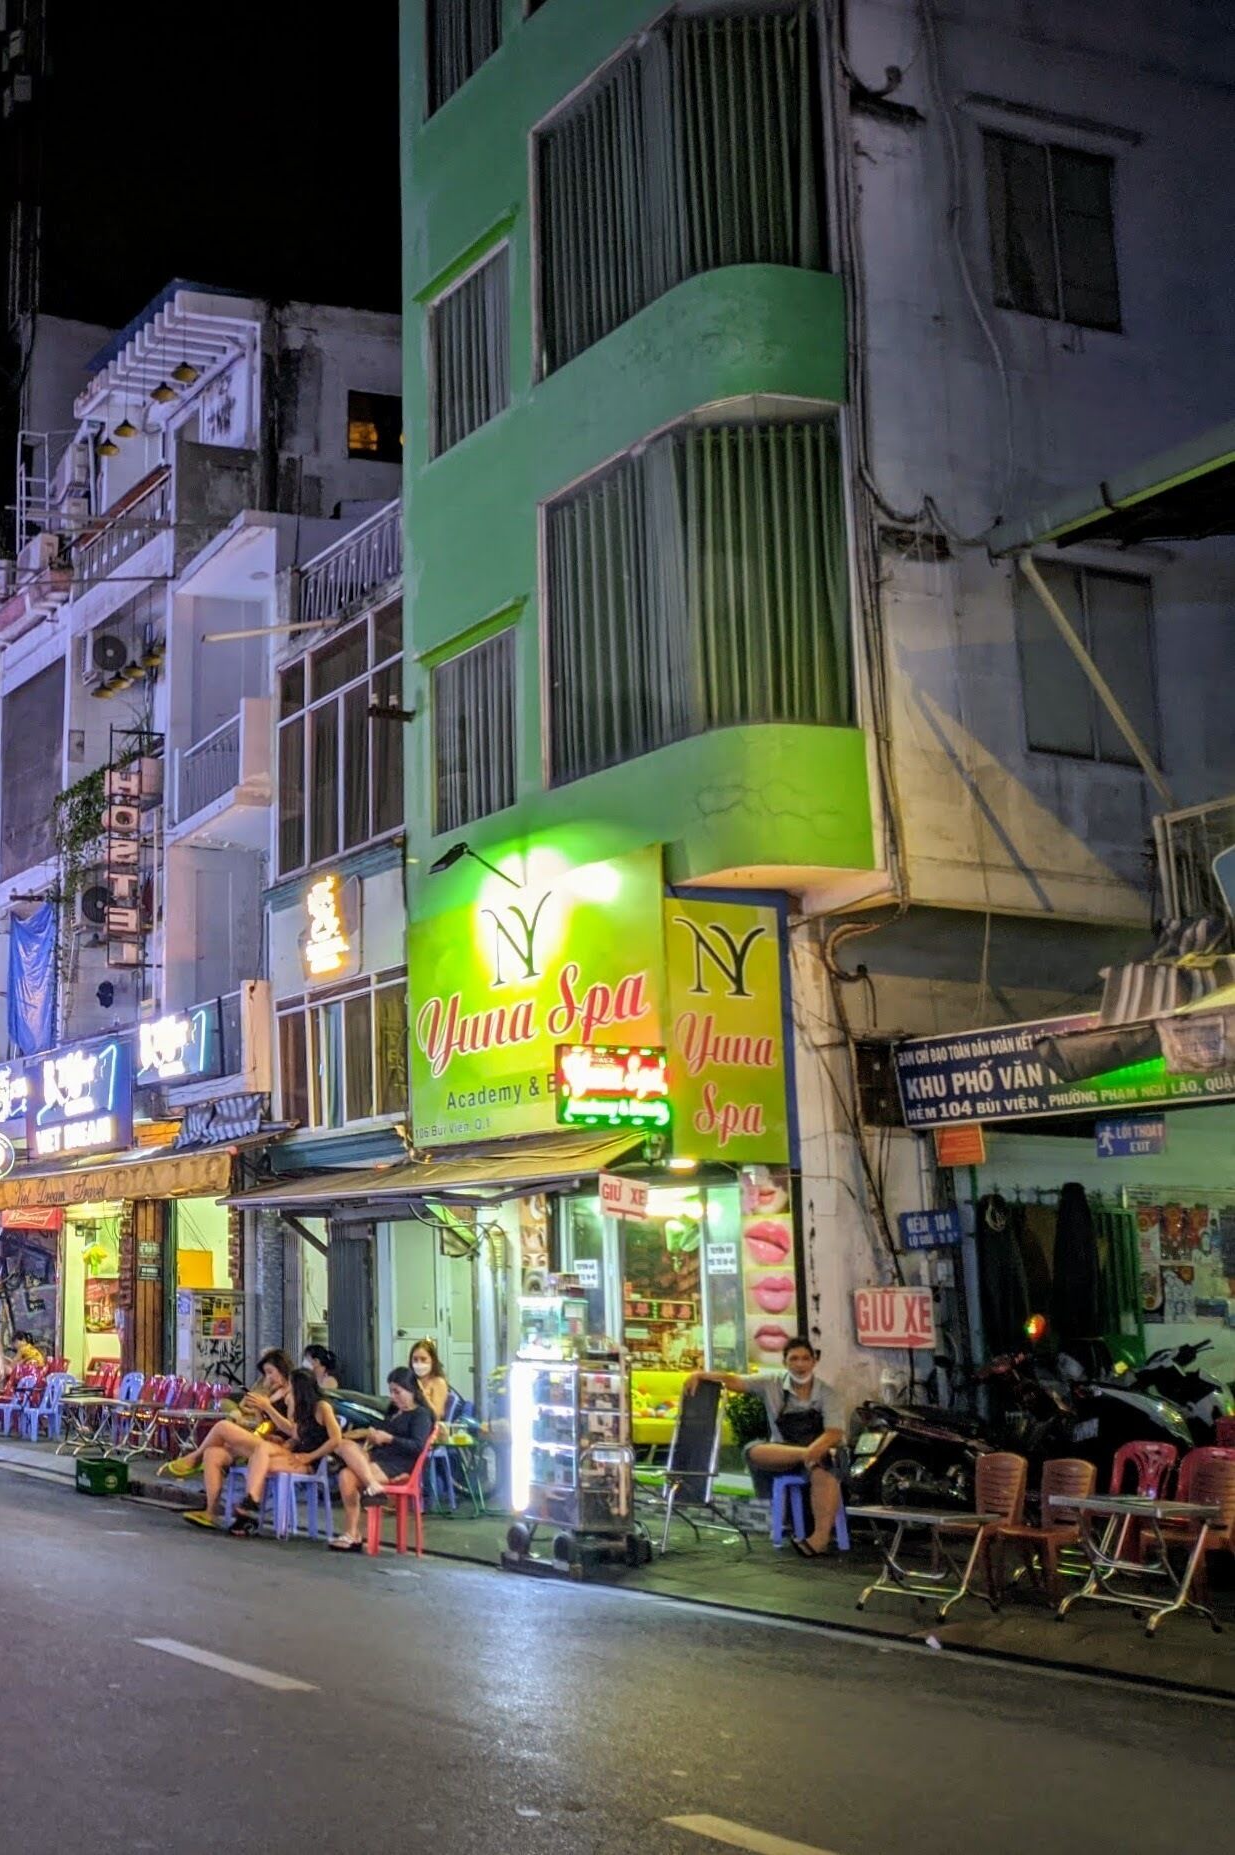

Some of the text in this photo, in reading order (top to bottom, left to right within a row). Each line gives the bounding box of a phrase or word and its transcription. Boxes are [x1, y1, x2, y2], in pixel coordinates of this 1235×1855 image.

[418, 962, 650, 1076] Yuna Spa
[675, 1012, 776, 1074] Yuna
[915, 1044, 929, 1064] CHỈ
[930, 1048, 948, 1066] ĐẠO
[947, 1042, 971, 1061] TOÀN
[990, 1034, 1015, 1055] ĐOÀN
[1015, 1029, 1034, 1051] KẾT
[447, 1083, 522, 1110] Academy
[529, 1075, 540, 1097] &
[905, 1073, 947, 1101] KHU
[951, 1059, 995, 1096] PHỐ
[997, 1060, 1044, 1091] VĂN
[939, 1100, 973, 1118] 104
[976, 1096, 1002, 1114] BÙI
[1049, 1087, 1098, 1106] PHƯỜNG
[1101, 1087, 1138, 1104] PHẠM
[1204, 1072, 1235, 1093] QUẬ
[694, 1082, 765, 1146] Spa
[1129, 1141, 1151, 1153] EXIT
[630, 1187, 647, 1206] XE
[904, 1295, 933, 1333] XE
